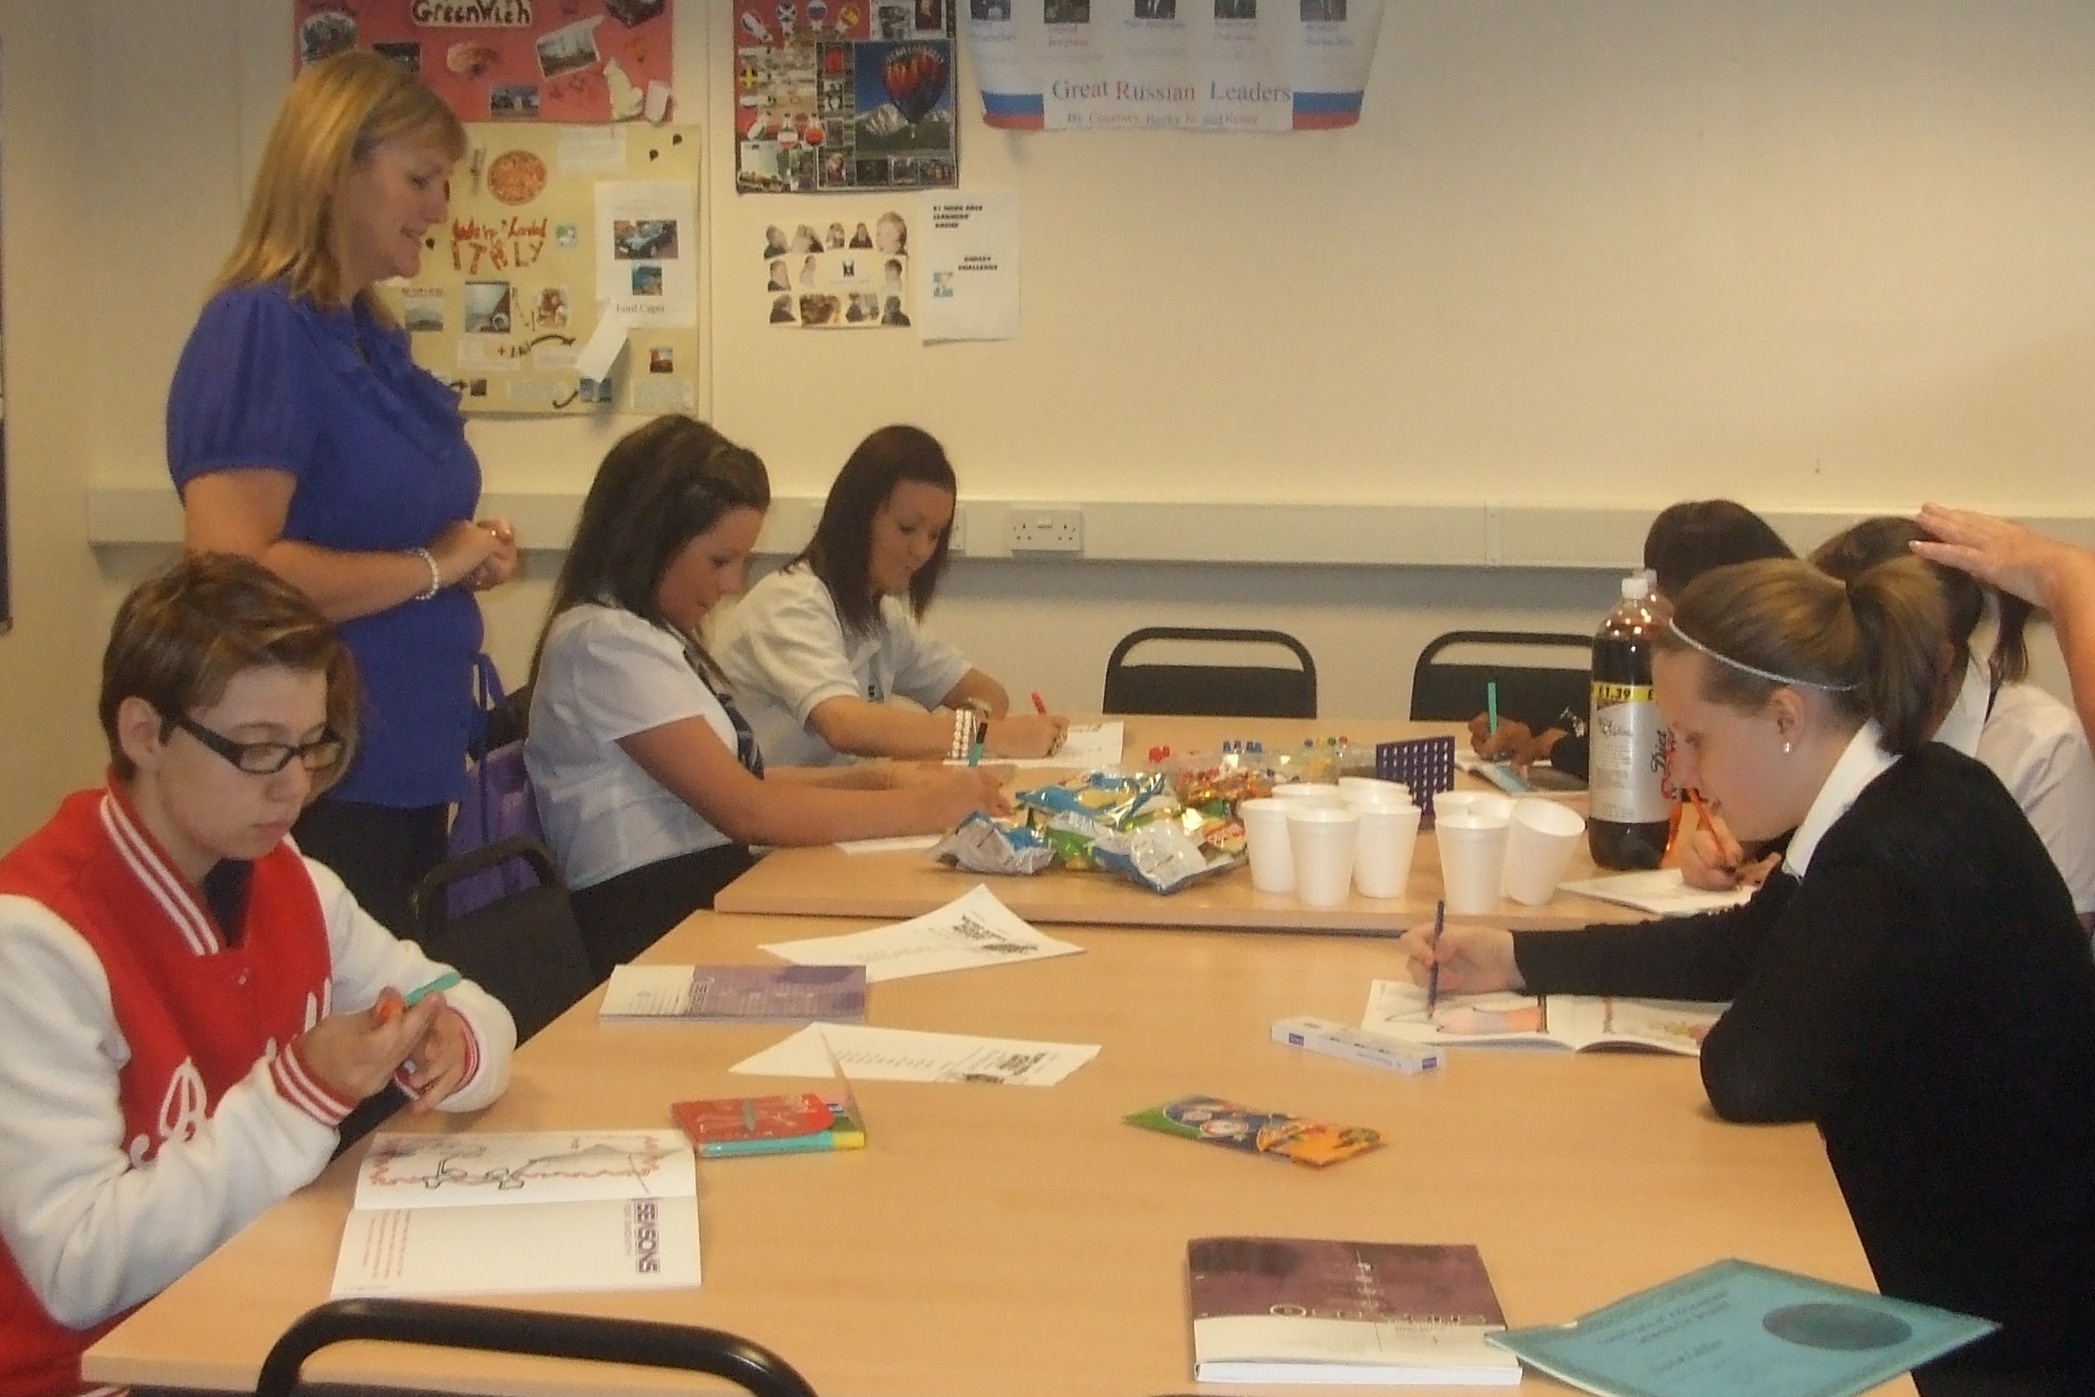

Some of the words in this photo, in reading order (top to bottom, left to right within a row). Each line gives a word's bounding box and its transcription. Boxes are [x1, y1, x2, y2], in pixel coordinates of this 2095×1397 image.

[1051, 79, 1108, 100] Great
[1117, 81, 1196, 101] Russian
[1210, 81, 1291, 102] Leaders
[450, 239, 545, 275] ITALY
